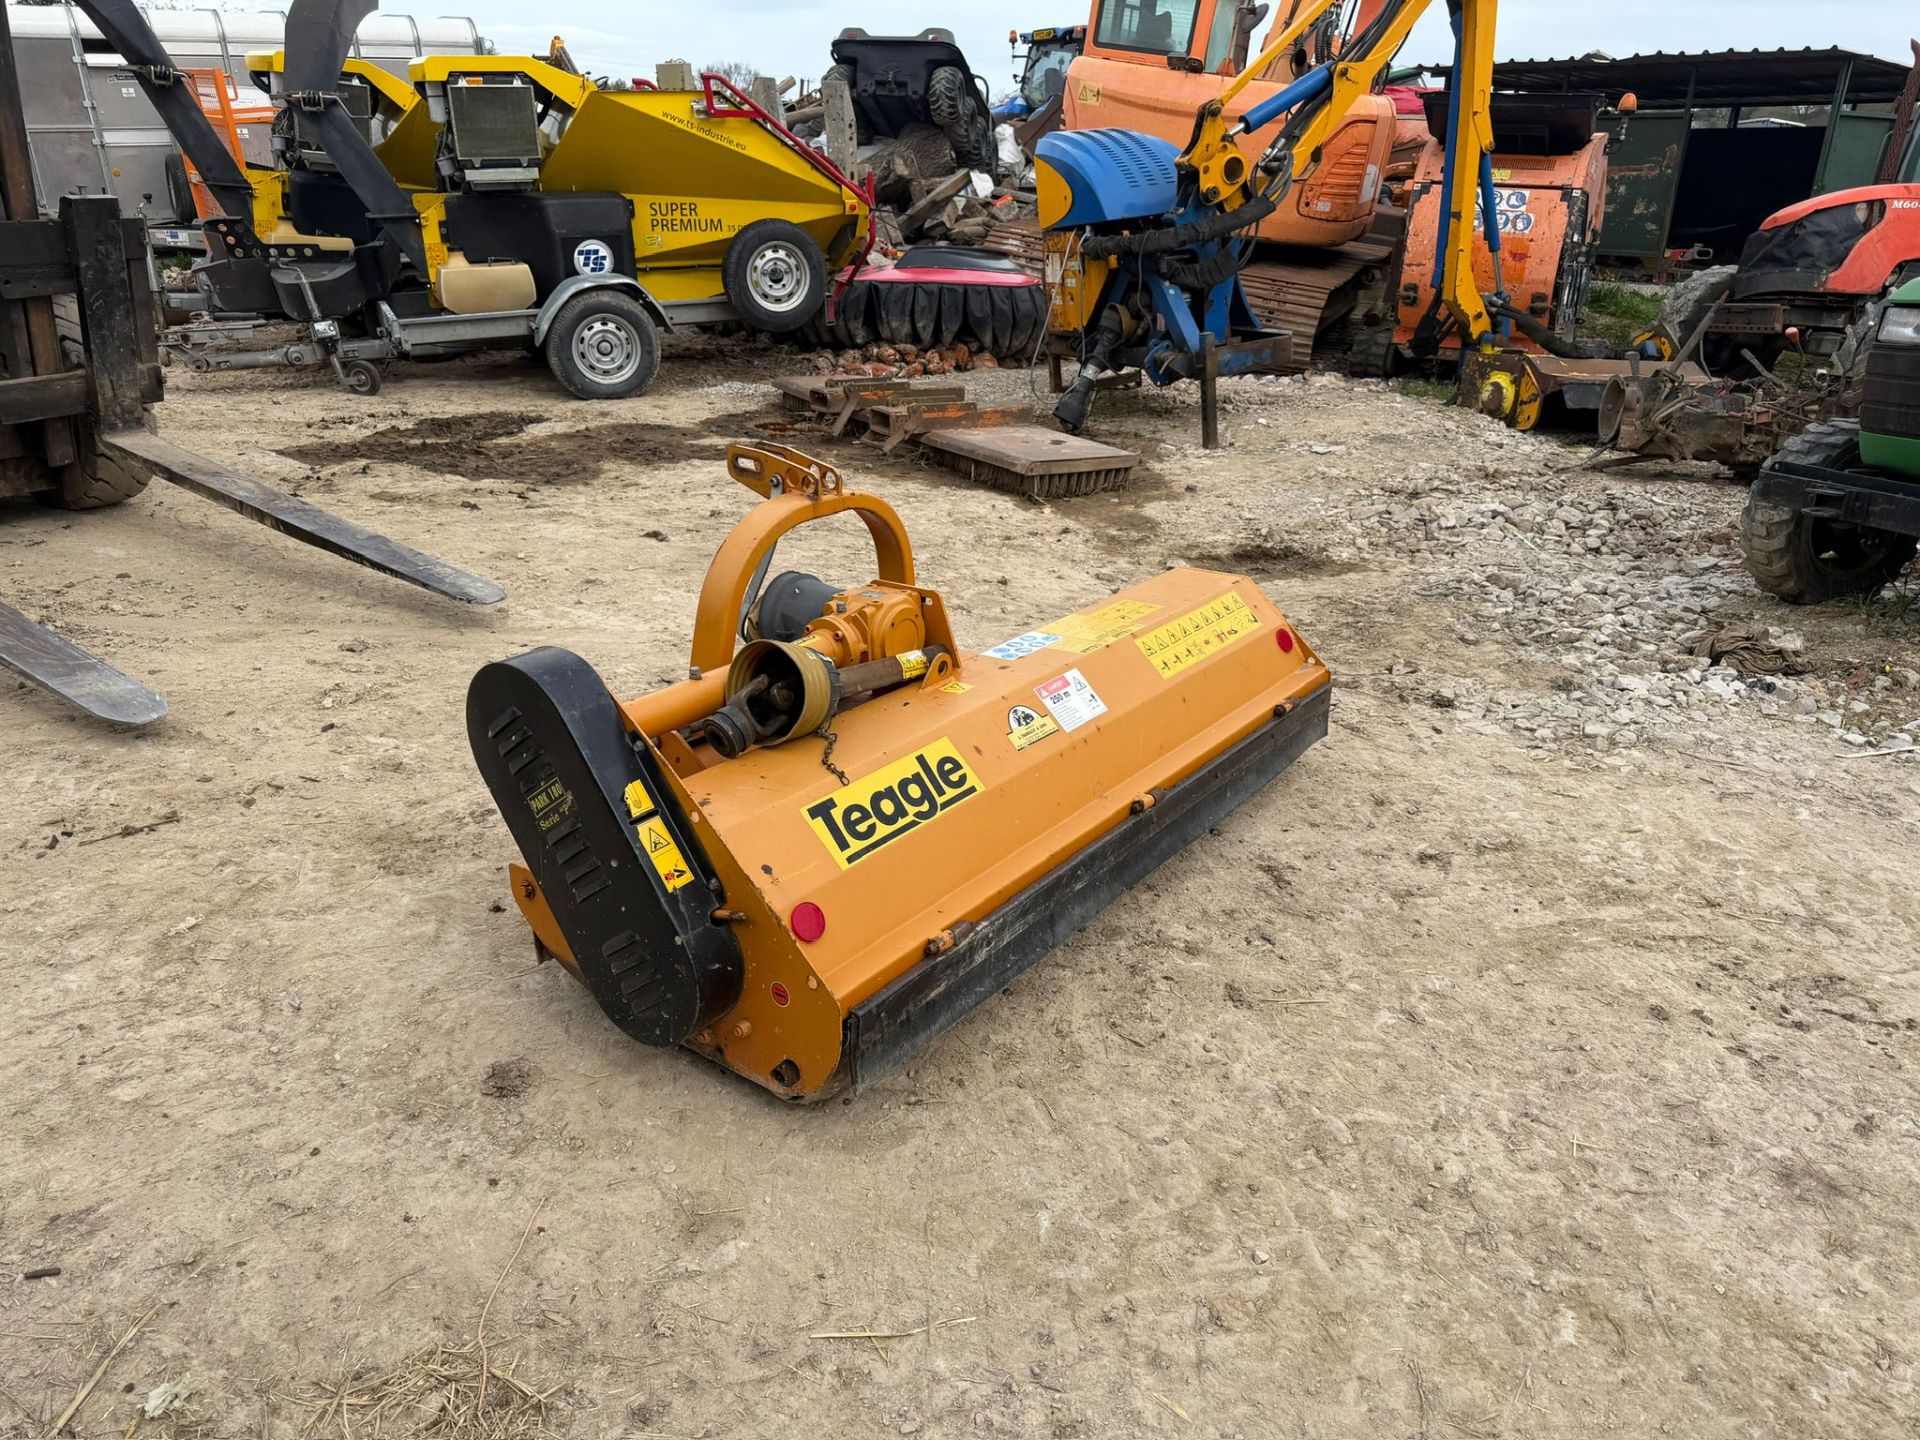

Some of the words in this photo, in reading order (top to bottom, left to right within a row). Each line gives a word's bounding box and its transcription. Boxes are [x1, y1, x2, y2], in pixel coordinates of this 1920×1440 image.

[662, 111, 747, 151] www.ts-industrie.eu
[649, 202, 698, 217] SUPER
[1891, 200, 1920, 209] M60
[651, 219, 723, 232] PREMIUM
[577, 249, 607, 273] TS
[1049, 693, 1064, 705] 250
[530, 791, 551, 812] PARK
[547, 783, 564, 800] 180
[807, 753, 968, 853] Teagle
[539, 813, 560, 831] Serie
